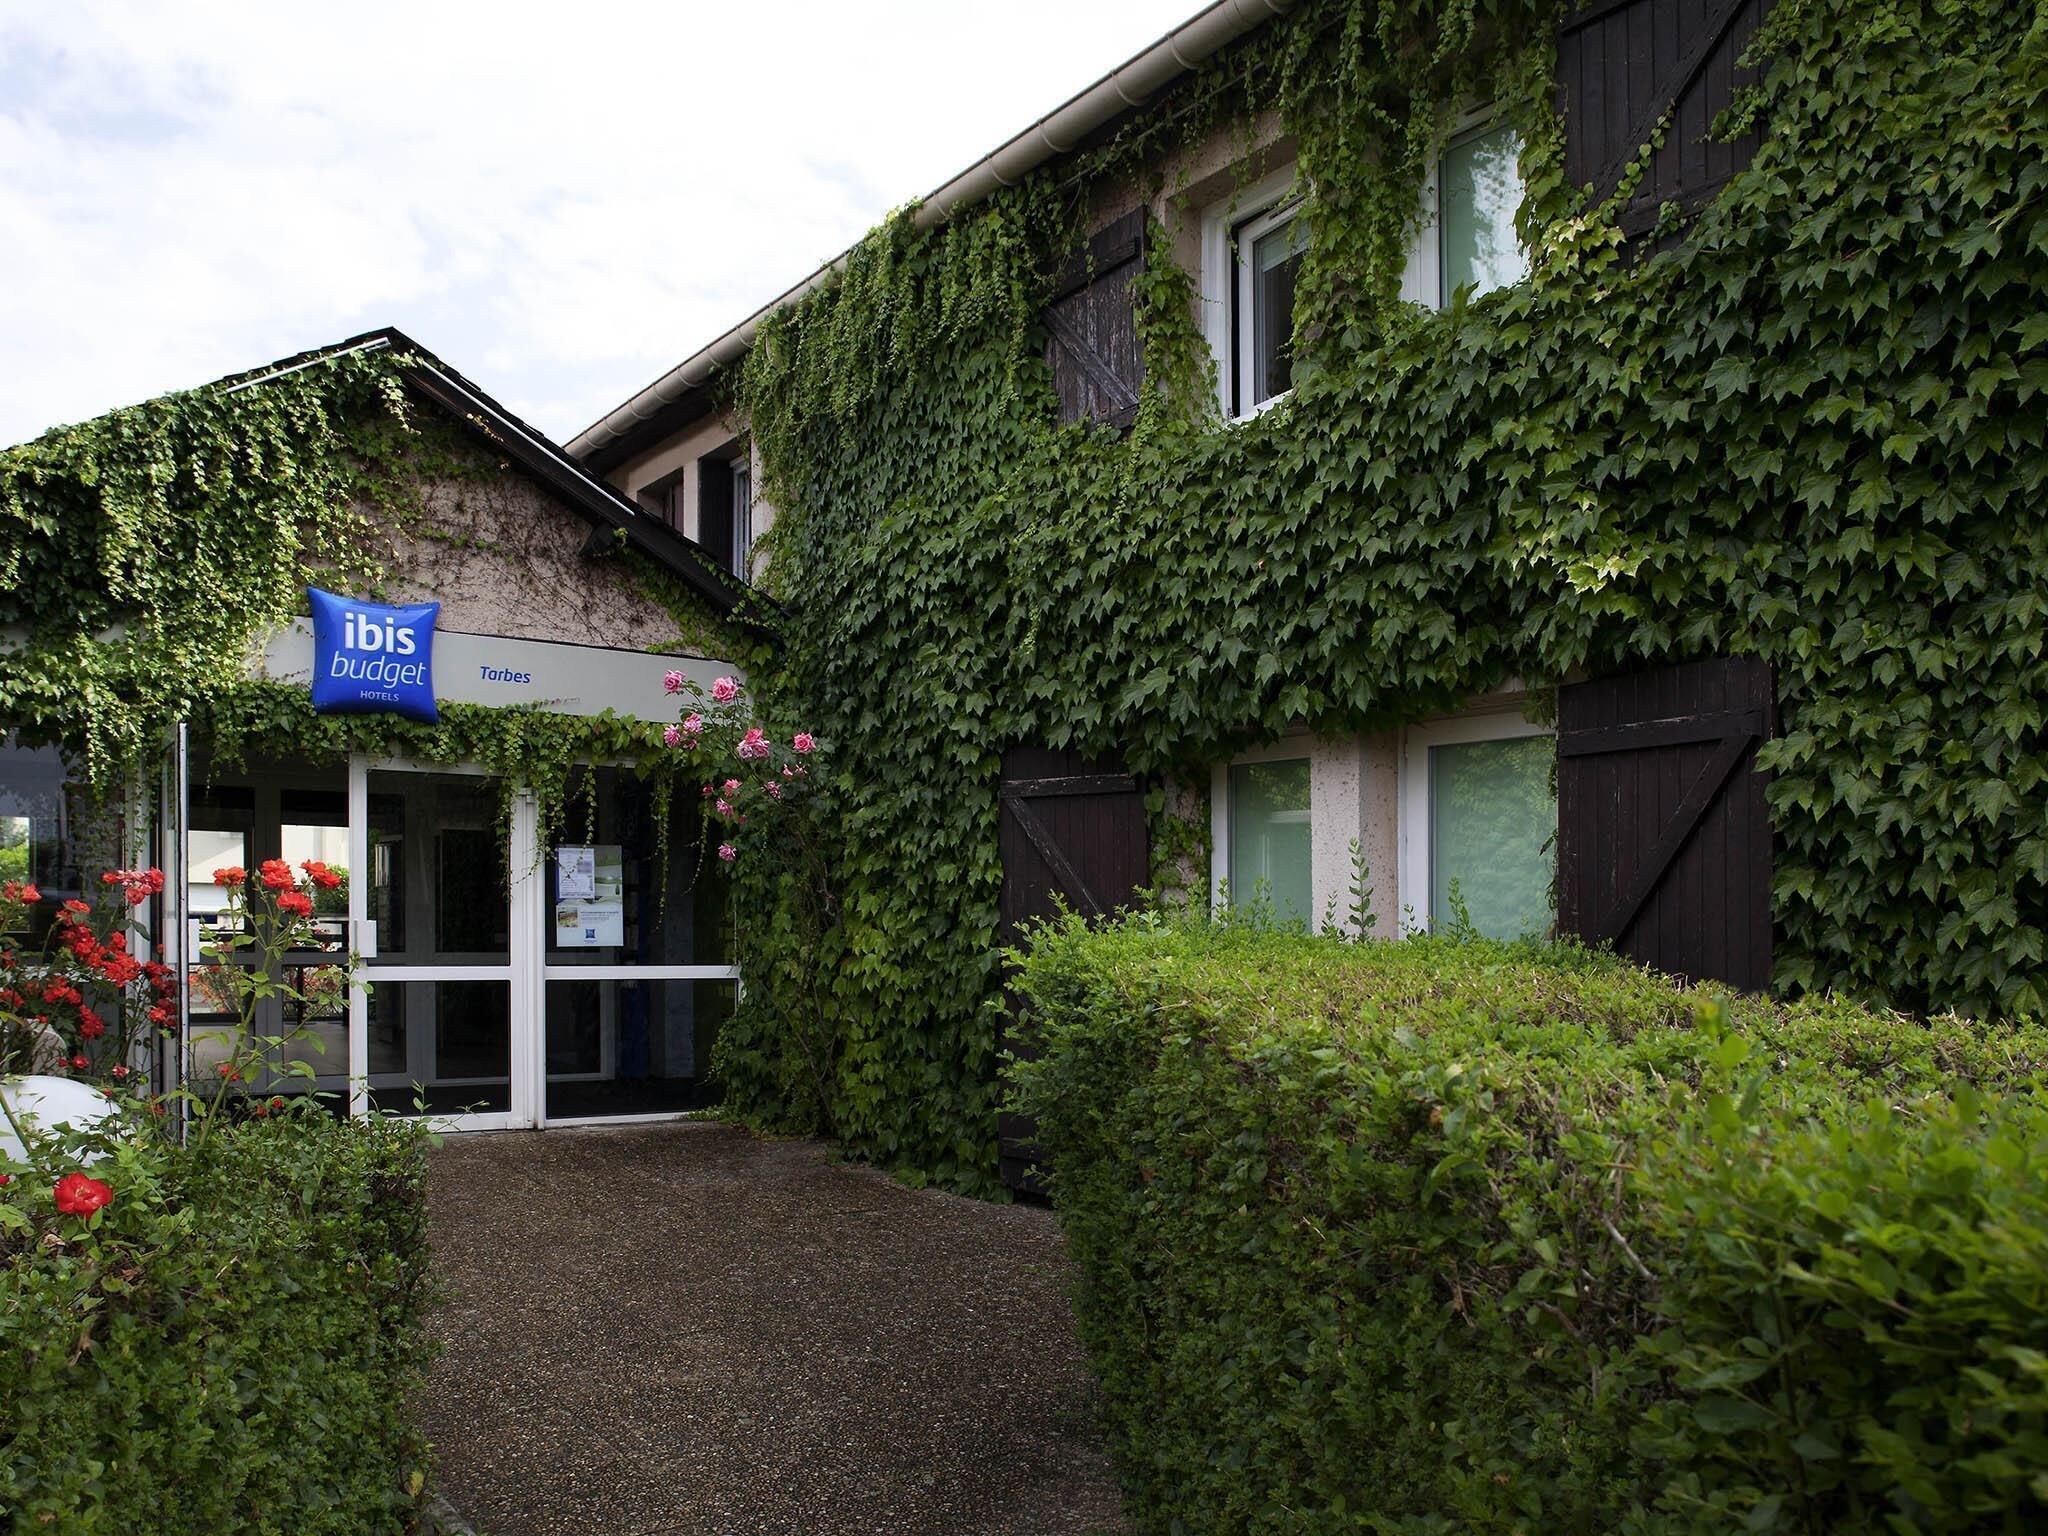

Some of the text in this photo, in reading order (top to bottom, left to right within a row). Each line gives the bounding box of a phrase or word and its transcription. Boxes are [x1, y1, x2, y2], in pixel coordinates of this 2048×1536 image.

[344, 612, 416, 654] ibis
[330, 650, 426, 688] budget
[480, 666, 531, 684] Tarbes
[360, 689, 399, 701] HOTELS
